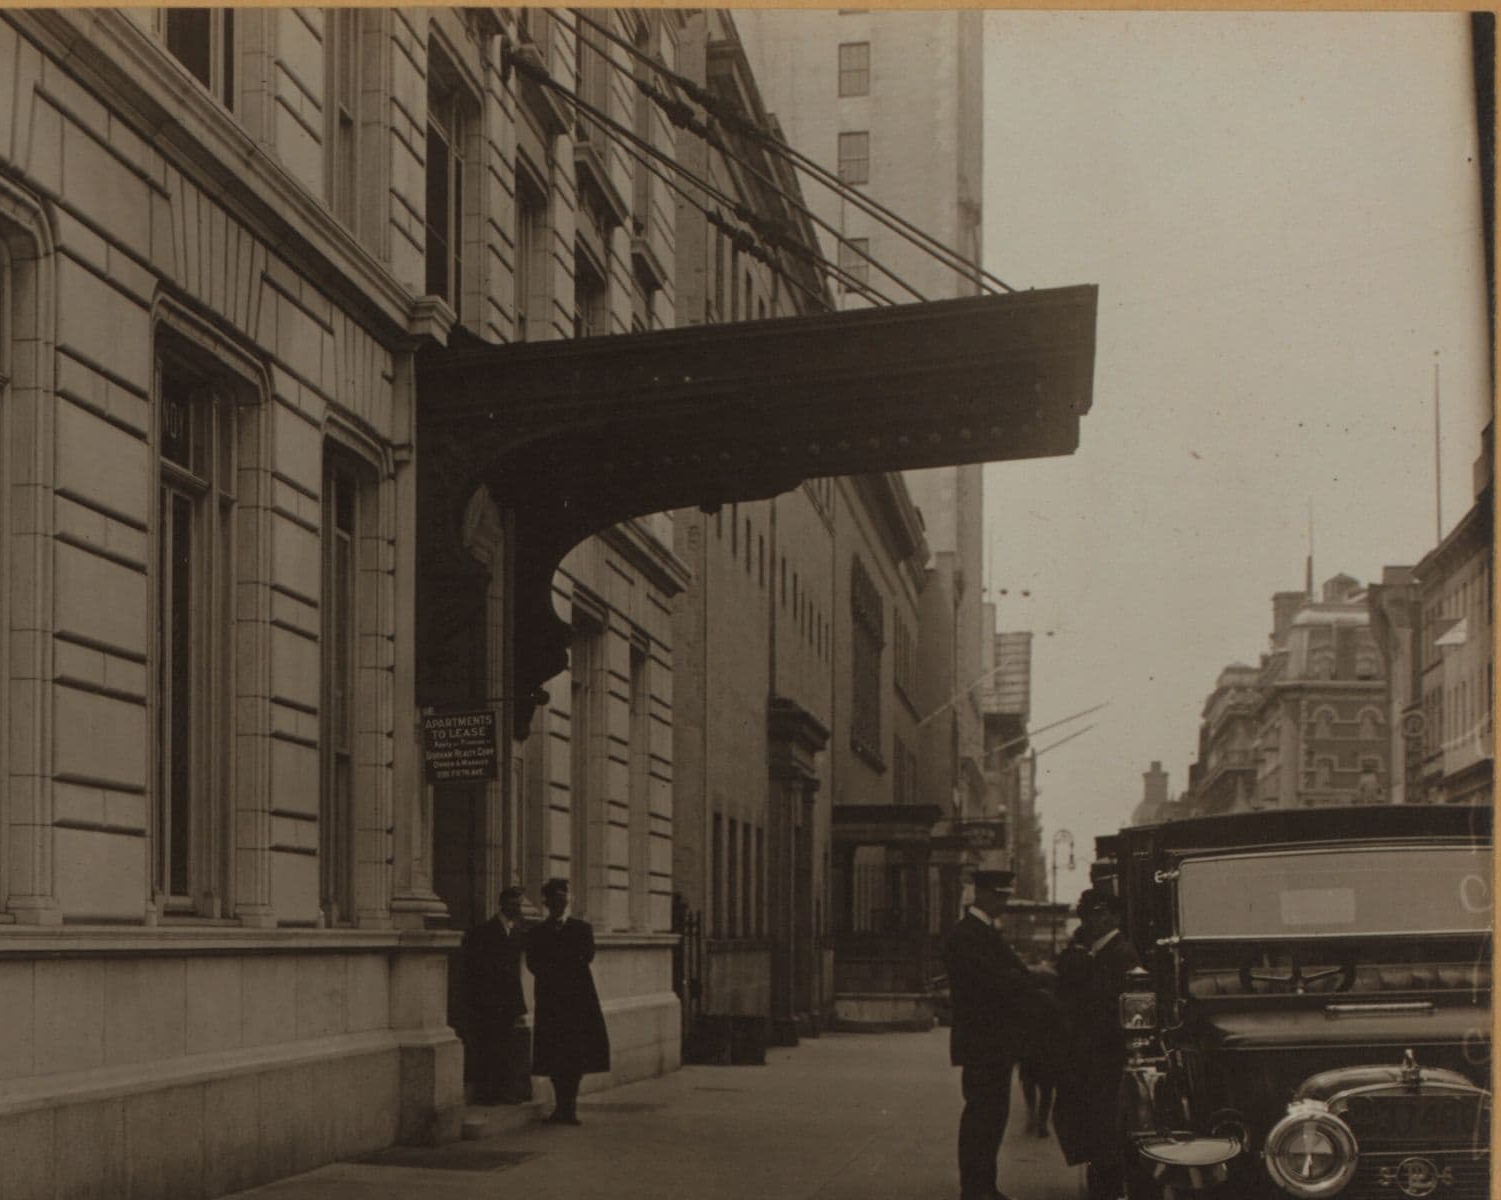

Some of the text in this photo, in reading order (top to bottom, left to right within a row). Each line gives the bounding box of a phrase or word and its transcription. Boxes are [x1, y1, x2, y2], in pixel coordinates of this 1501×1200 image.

[425, 714, 493, 729] APARTMENTS
[431, 726, 486, 740] TO LEASE
